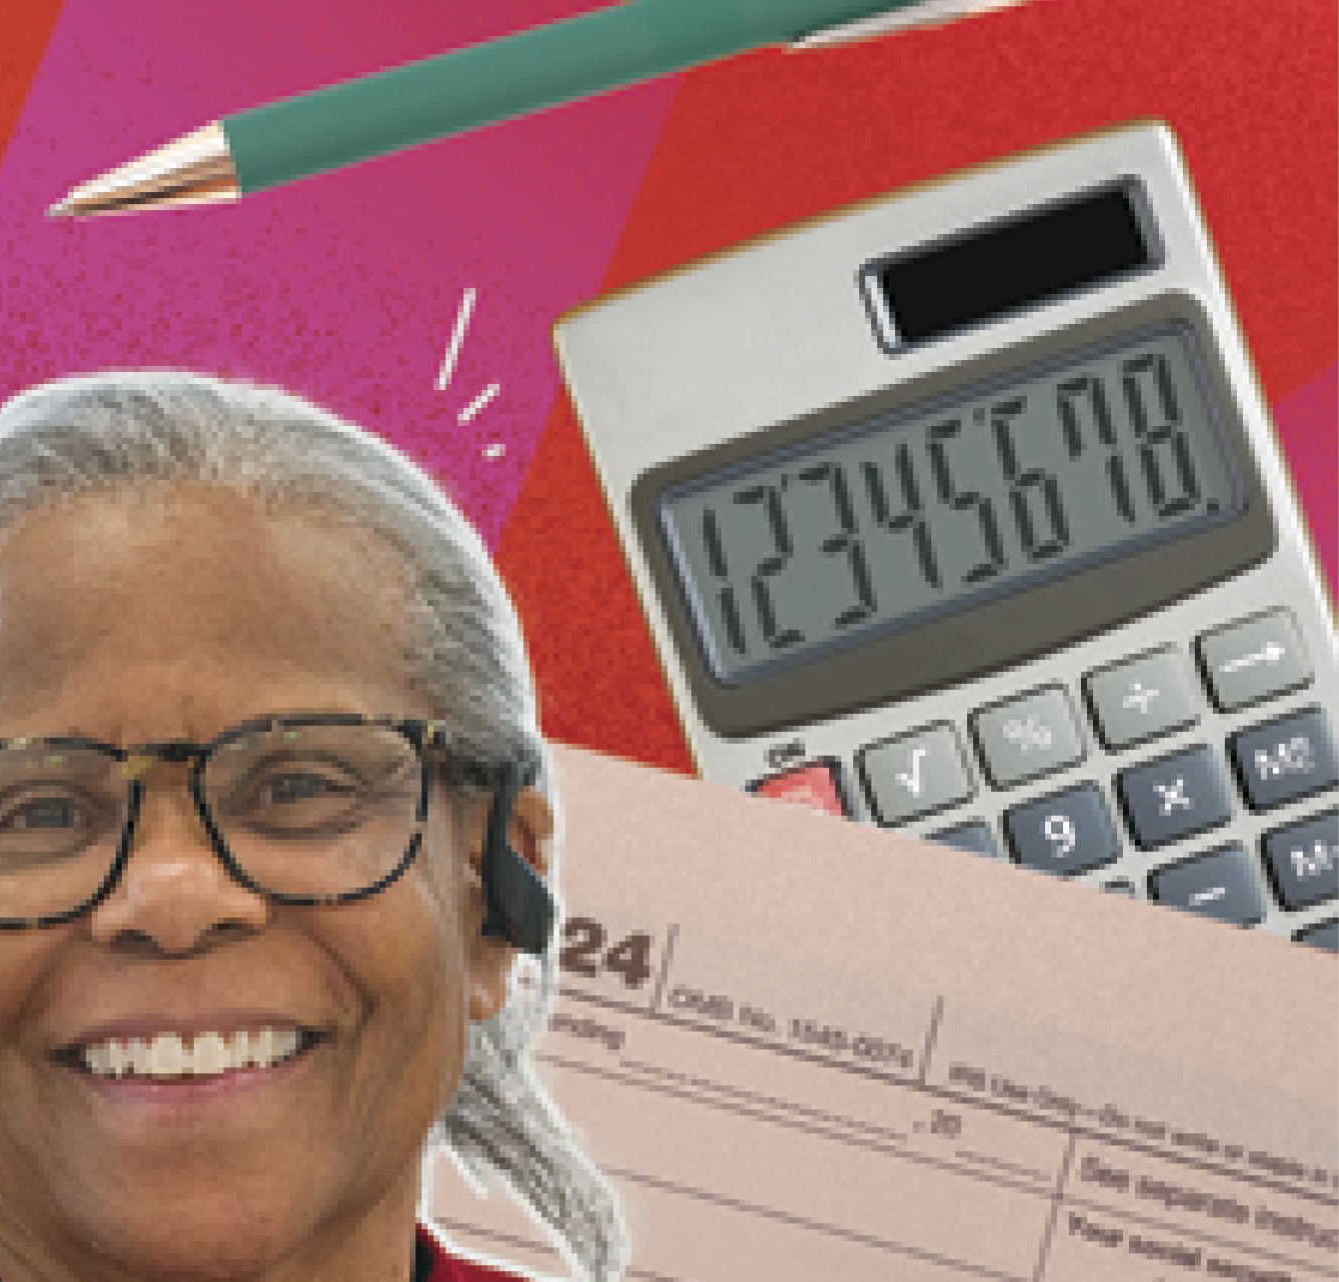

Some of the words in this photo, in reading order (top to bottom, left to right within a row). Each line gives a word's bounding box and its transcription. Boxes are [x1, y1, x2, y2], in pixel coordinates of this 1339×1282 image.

[1042, 811, 1079, 860] 9
[558, 916, 652, 990] 24
[668, 984, 735, 1025] OMB
[738, 1003, 781, 1036] No.
[1079, 1154, 1130, 1193] See
[1134, 1174, 1250, 1224] separate
[1067, 1210, 1123, 1248] Your
[1128, 1234, 1202, 1270] social
